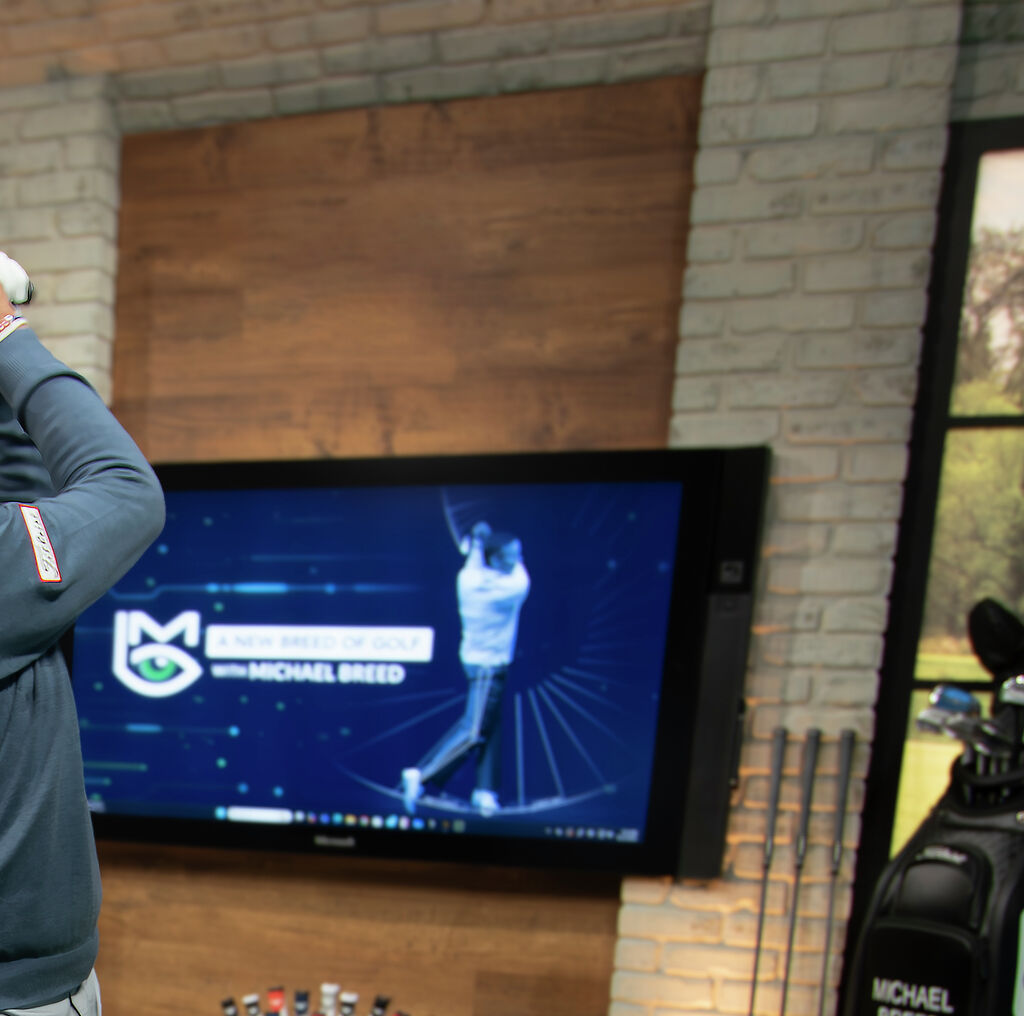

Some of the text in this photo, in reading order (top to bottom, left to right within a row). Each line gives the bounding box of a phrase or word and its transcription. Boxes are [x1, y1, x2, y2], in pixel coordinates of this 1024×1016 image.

[248, 661, 336, 682] MICHAEL
[337, 663, 406, 684] BREED
[872, 976, 954, 1014] MICHAEL
